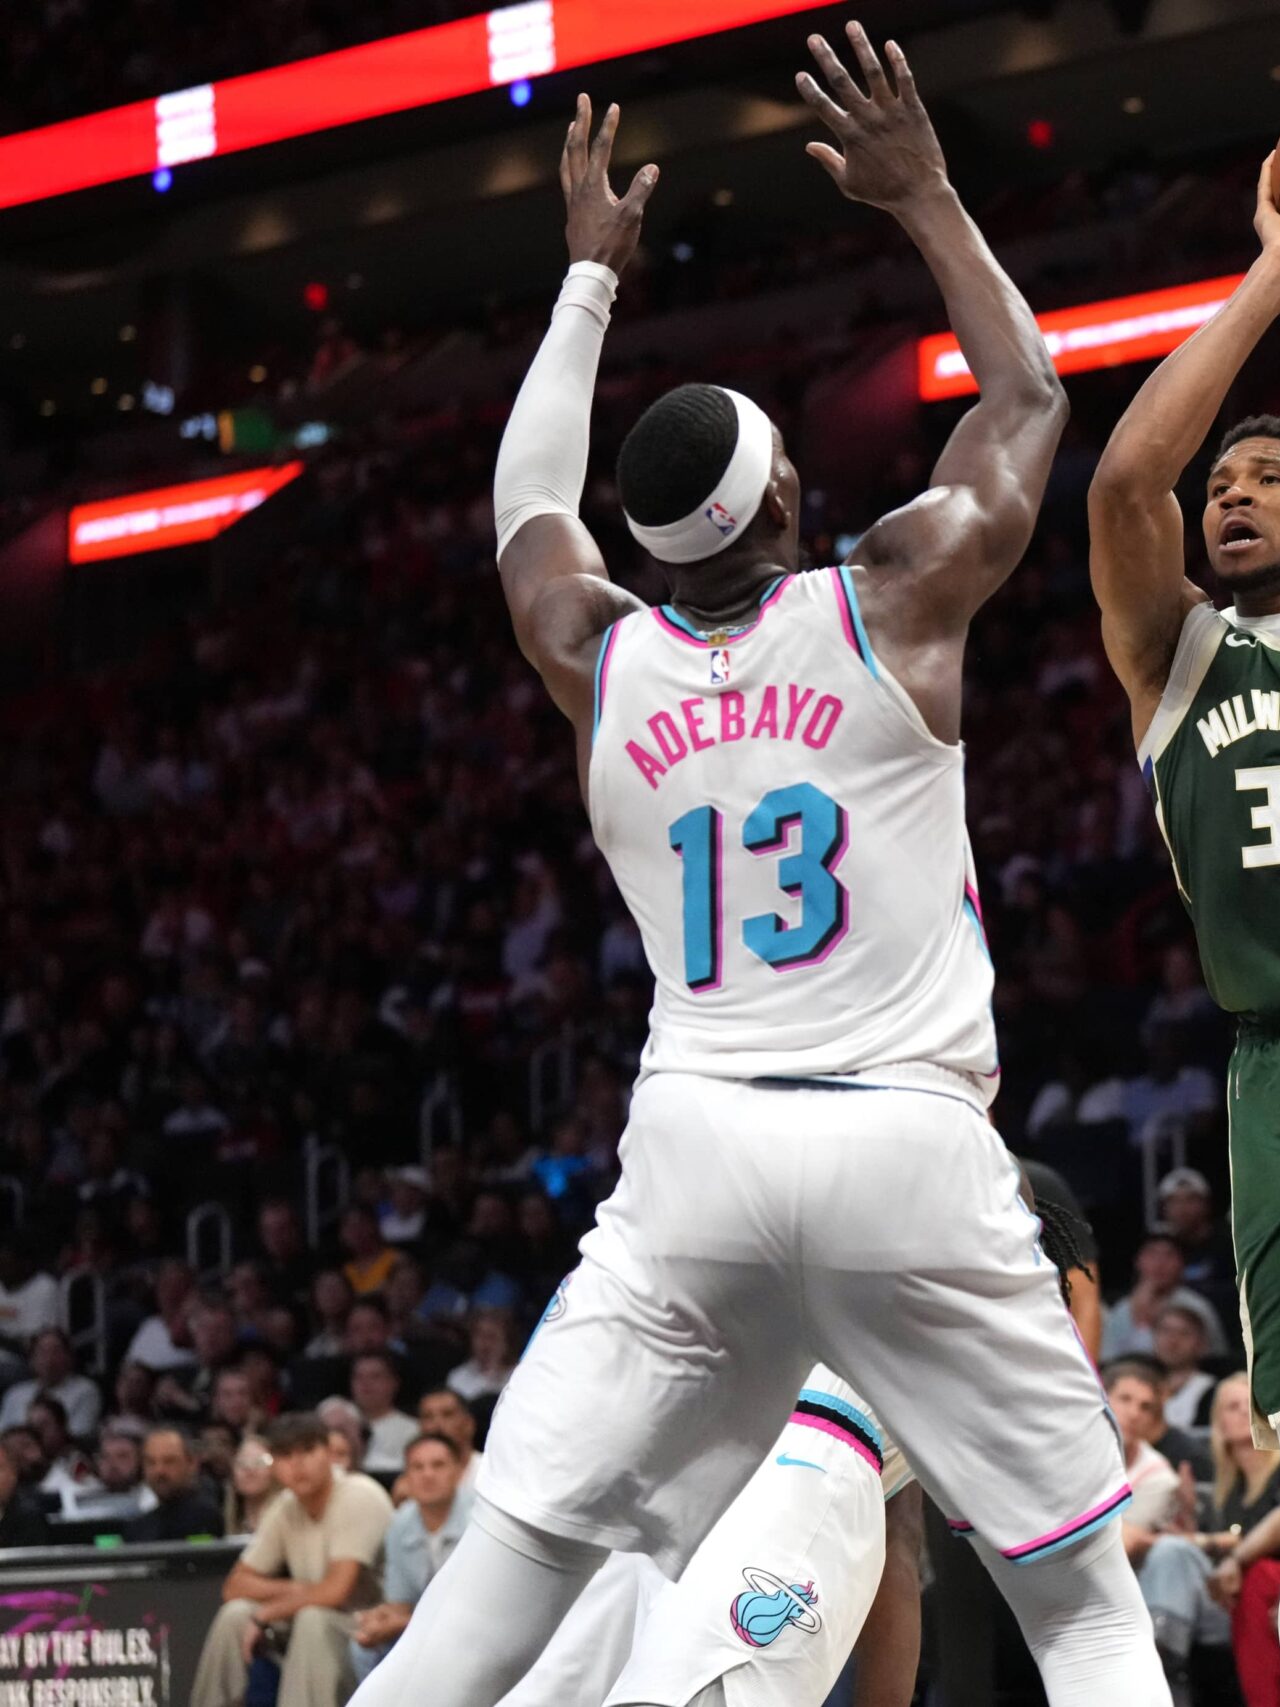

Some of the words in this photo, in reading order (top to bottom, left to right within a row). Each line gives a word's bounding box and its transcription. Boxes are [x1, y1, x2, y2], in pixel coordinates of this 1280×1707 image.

[624, 683, 844, 791] ADEBAYO
[668, 780, 850, 995] 13
[23, 1632, 48, 1669] BY
[50, 1630, 90, 1667] THE
